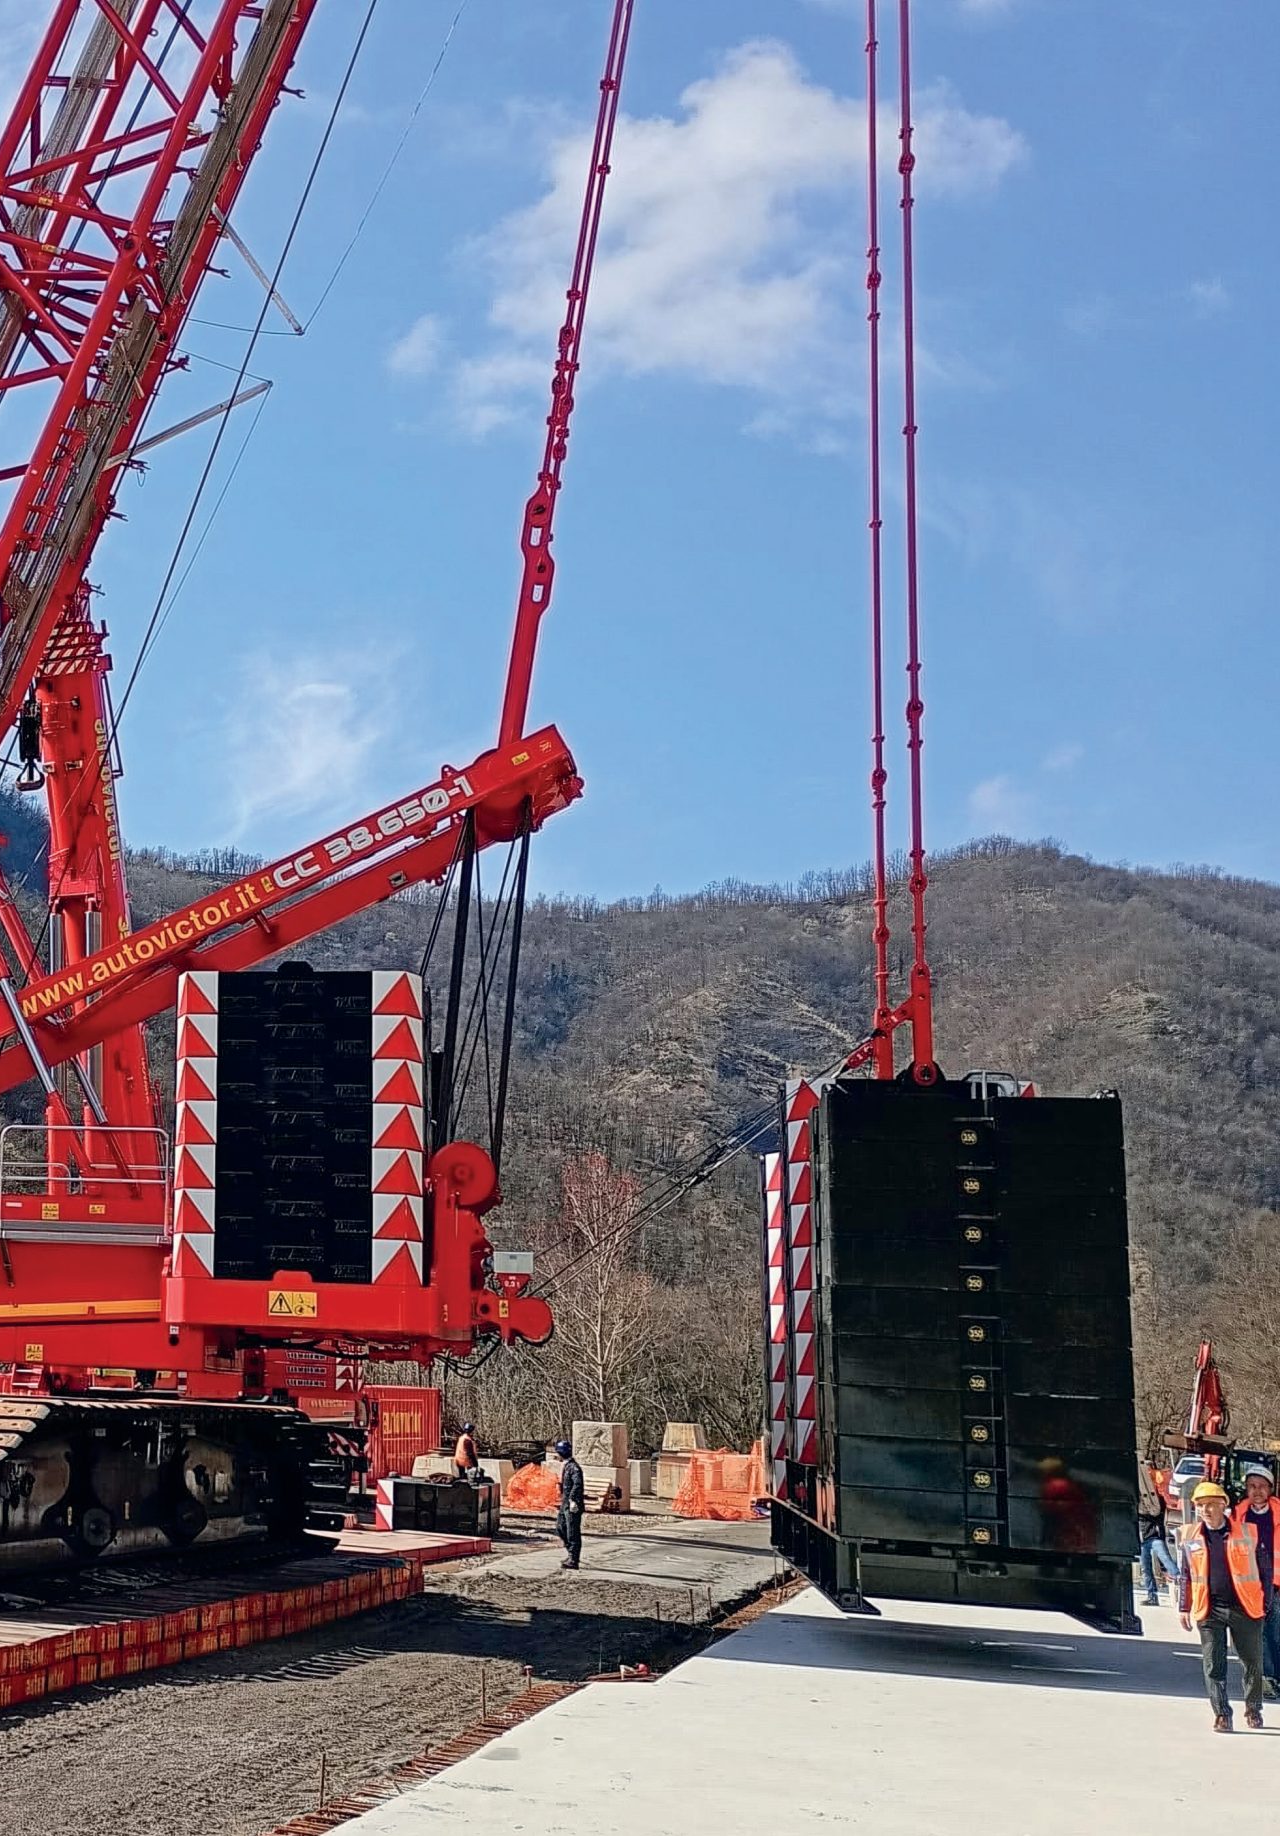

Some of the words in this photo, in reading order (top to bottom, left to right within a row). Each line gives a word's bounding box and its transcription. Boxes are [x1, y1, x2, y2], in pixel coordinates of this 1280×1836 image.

[273, 851, 321, 889] CC
[324, 775, 474, 864] 38.650-1
[22, 880, 261, 1018] www.autovictor.it
